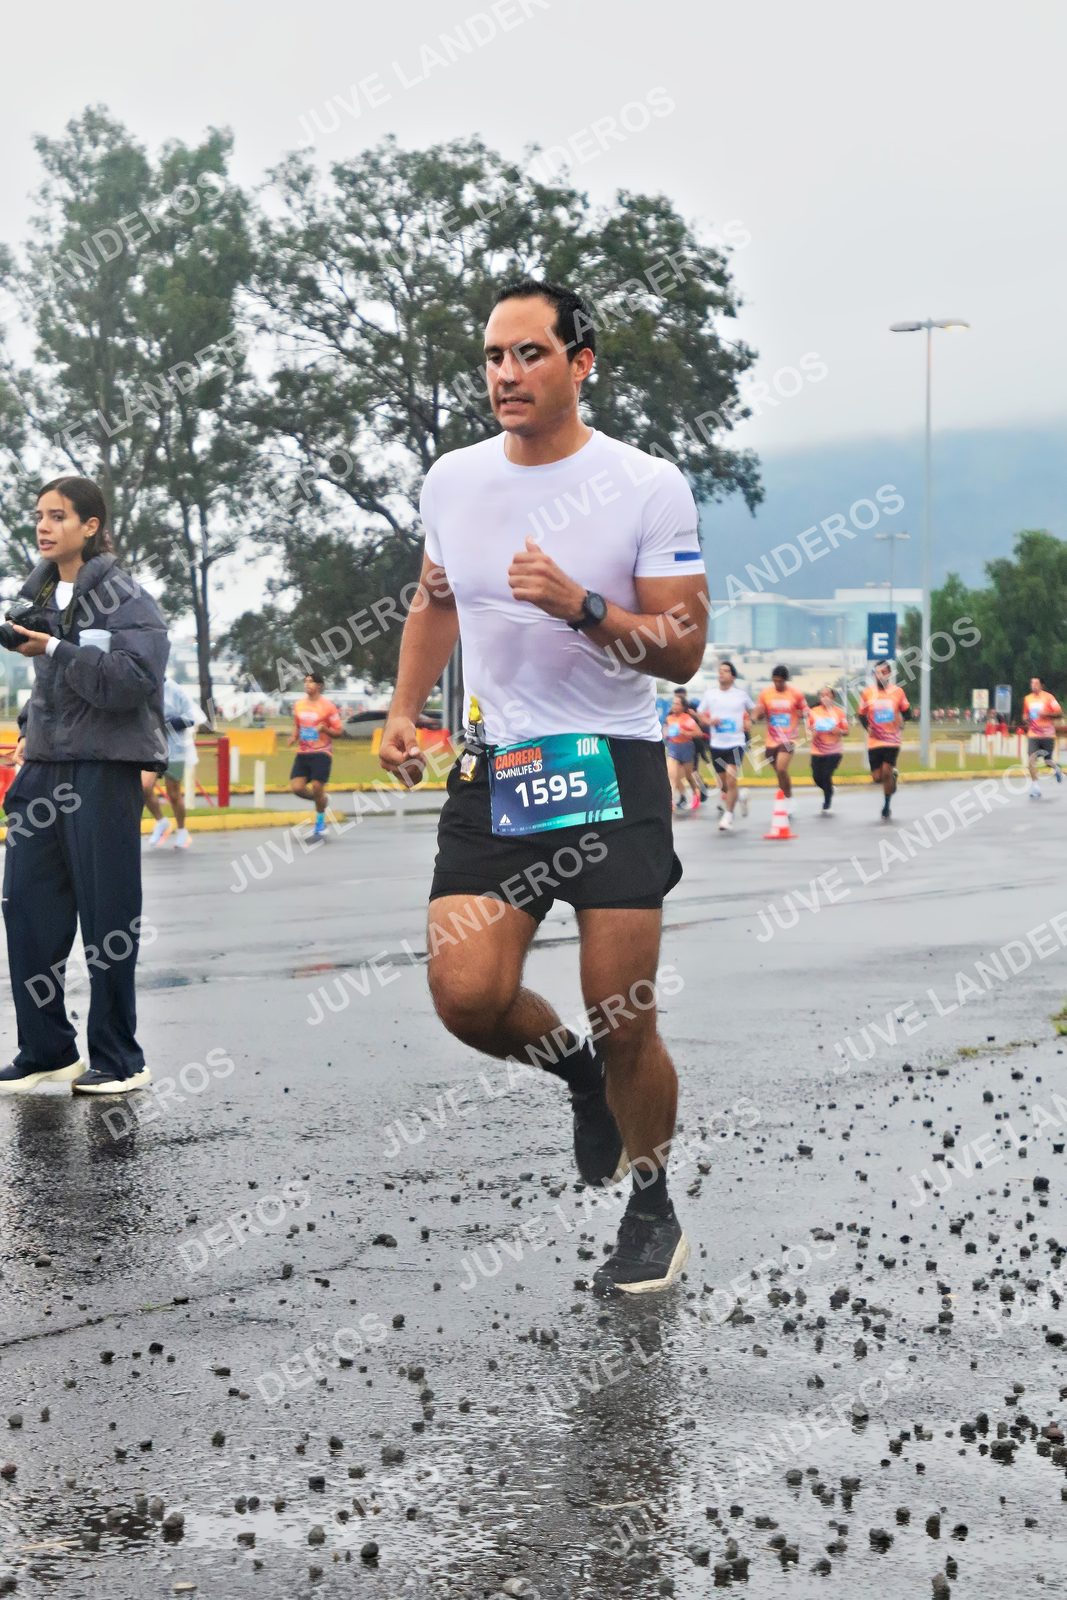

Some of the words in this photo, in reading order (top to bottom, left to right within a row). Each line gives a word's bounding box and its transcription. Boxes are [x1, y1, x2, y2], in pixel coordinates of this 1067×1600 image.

[872, 632, 889, 655] E
[495, 747, 542, 770] CARRERA
[576, 737, 600, 757] 10K
[496, 765, 533, 780] OMNILIFE
[515, 771, 588, 808] 1595
